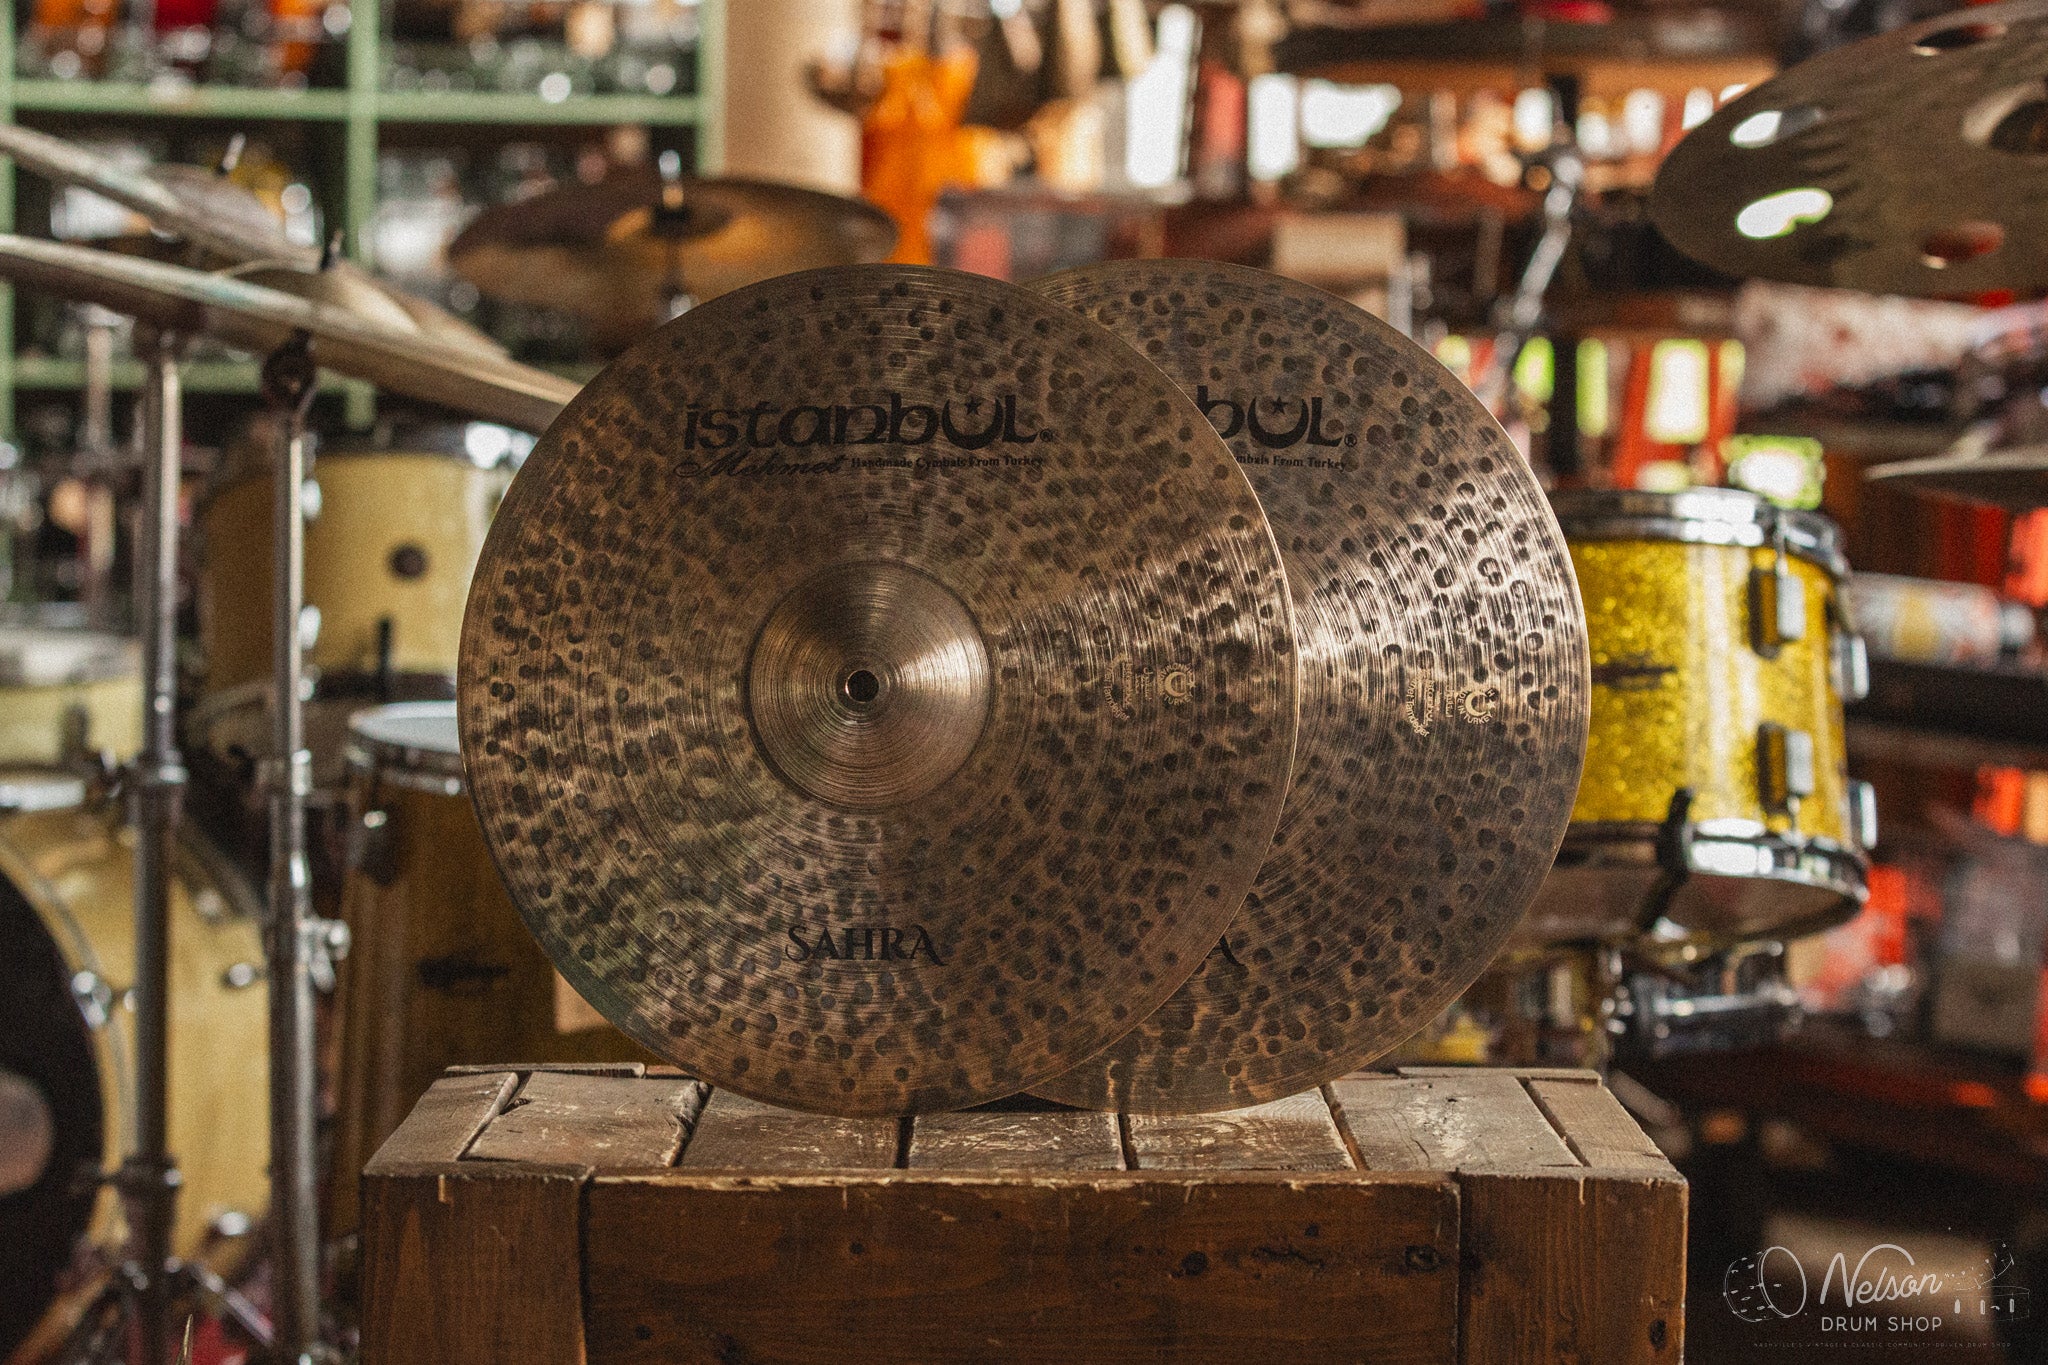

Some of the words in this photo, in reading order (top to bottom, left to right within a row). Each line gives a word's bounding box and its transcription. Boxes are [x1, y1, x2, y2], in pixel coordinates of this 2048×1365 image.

[673, 451, 849, 478] Mehmet
[851, 457, 912, 468] Handmade
[916, 457, 965, 469] Cymbals
[969, 456, 999, 467] From
[1004, 455, 1044, 467] Turkey
[1273, 455, 1303, 467] From
[1307, 457, 1347, 473] Turkey
[1463, 711, 1493, 725] TURKEY
[784, 924, 949, 966] SAHRA
